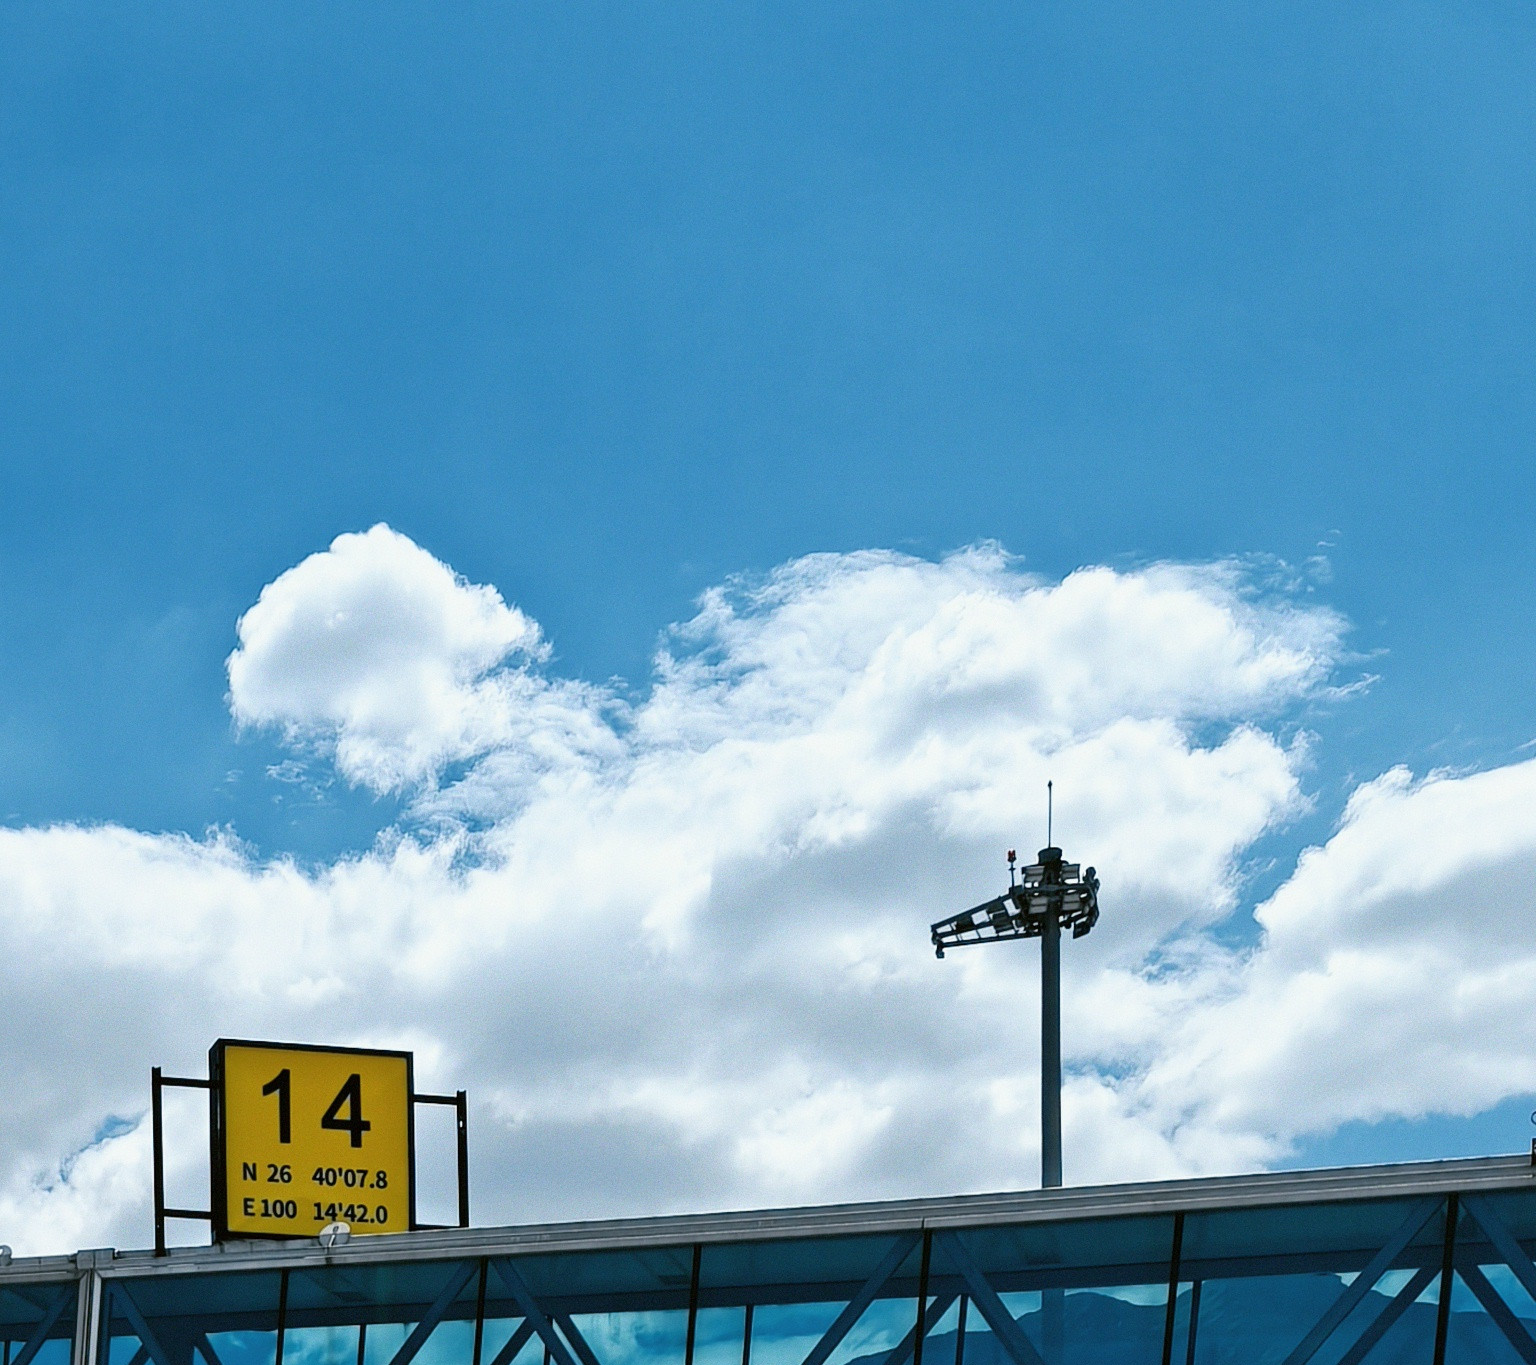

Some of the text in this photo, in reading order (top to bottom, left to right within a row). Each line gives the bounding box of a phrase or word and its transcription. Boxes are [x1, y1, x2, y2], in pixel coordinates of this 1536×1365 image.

[261, 1068, 371, 1148] 14
[242, 1162, 388, 1190] N 26 40'07.8
[243, 1197, 388, 1225] E 100 14'42.0
